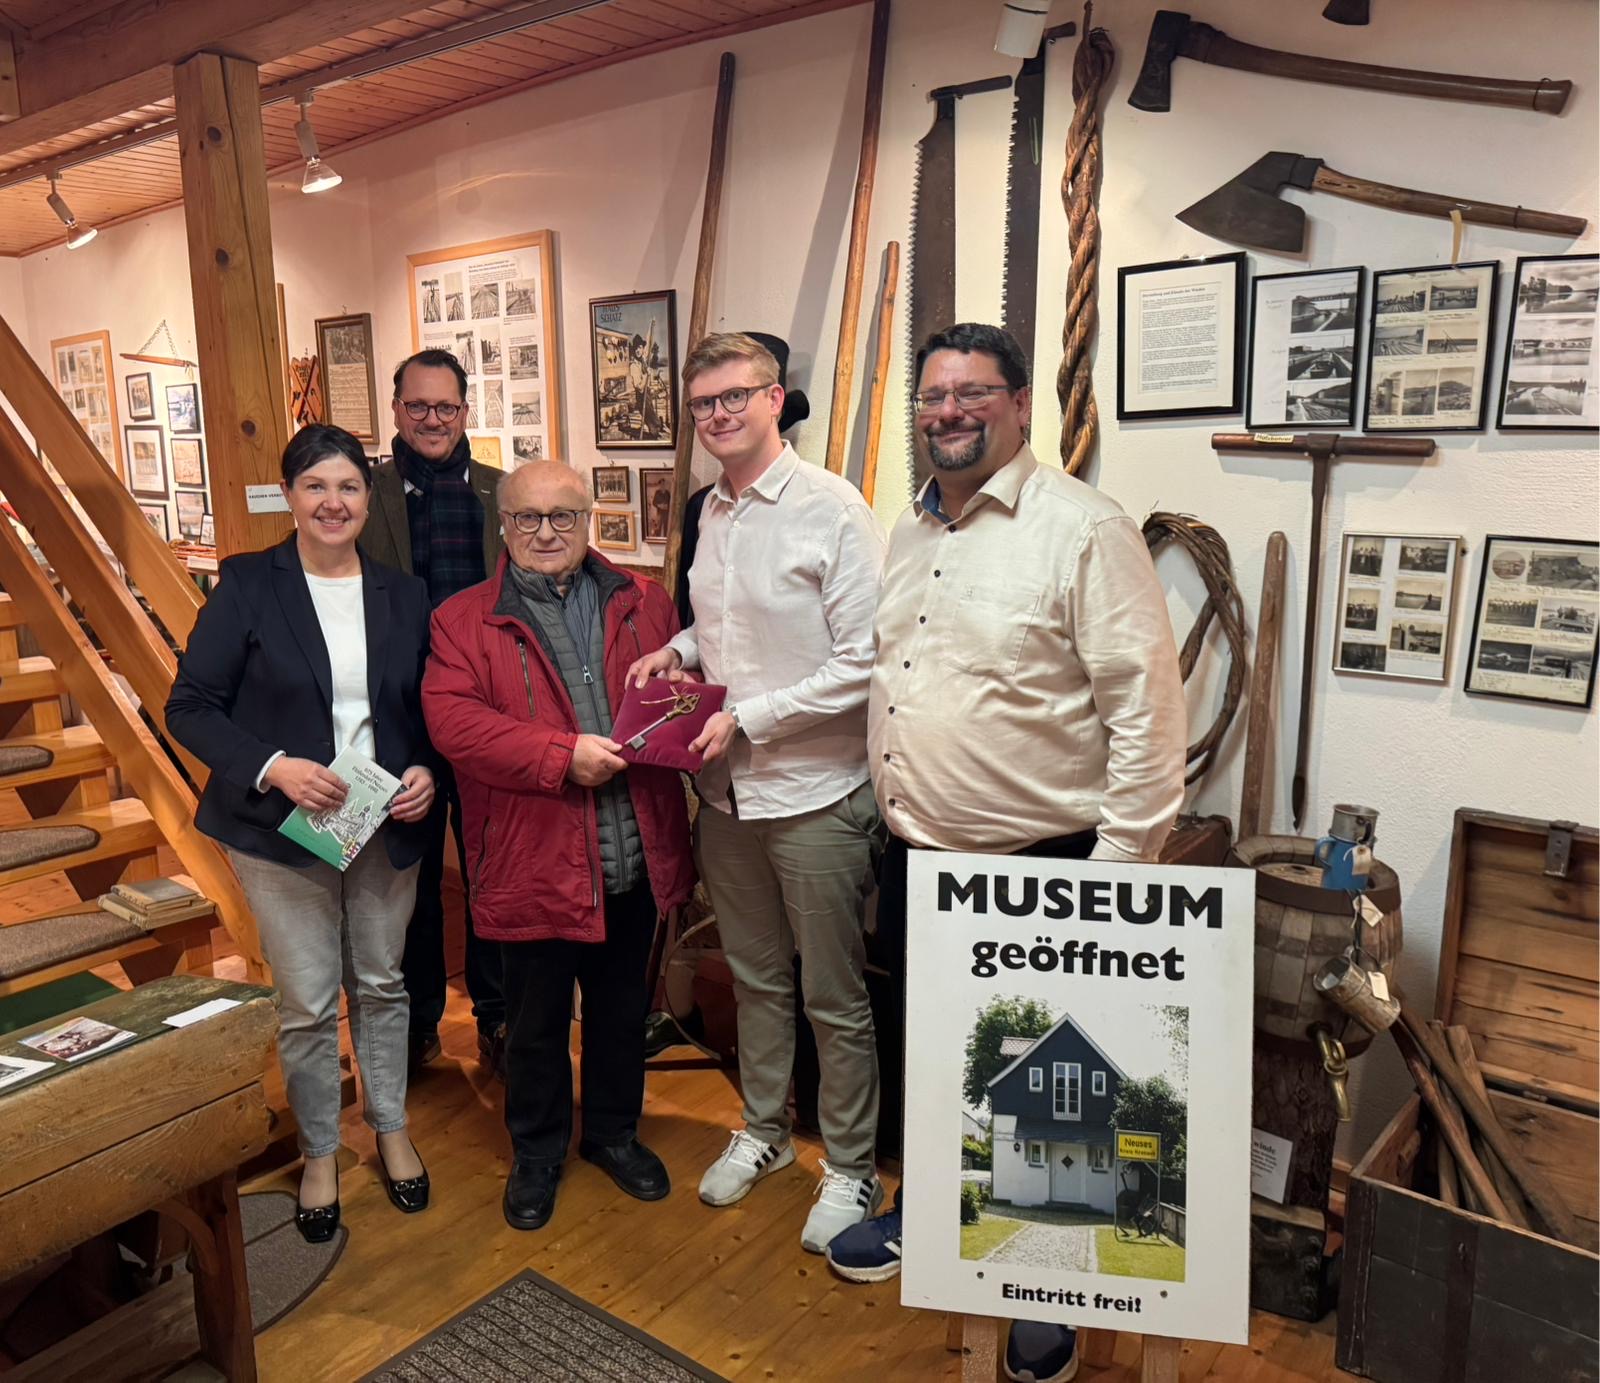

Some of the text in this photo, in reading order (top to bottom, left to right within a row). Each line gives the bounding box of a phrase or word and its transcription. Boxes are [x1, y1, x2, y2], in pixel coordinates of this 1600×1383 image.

[938, 871, 1223, 929] MUSEUM
[971, 936, 1185, 981] geöffnet
[1124, 1137, 1153, 1149] Neuses
[1002, 1283, 1142, 1313] Eintritt frei!
